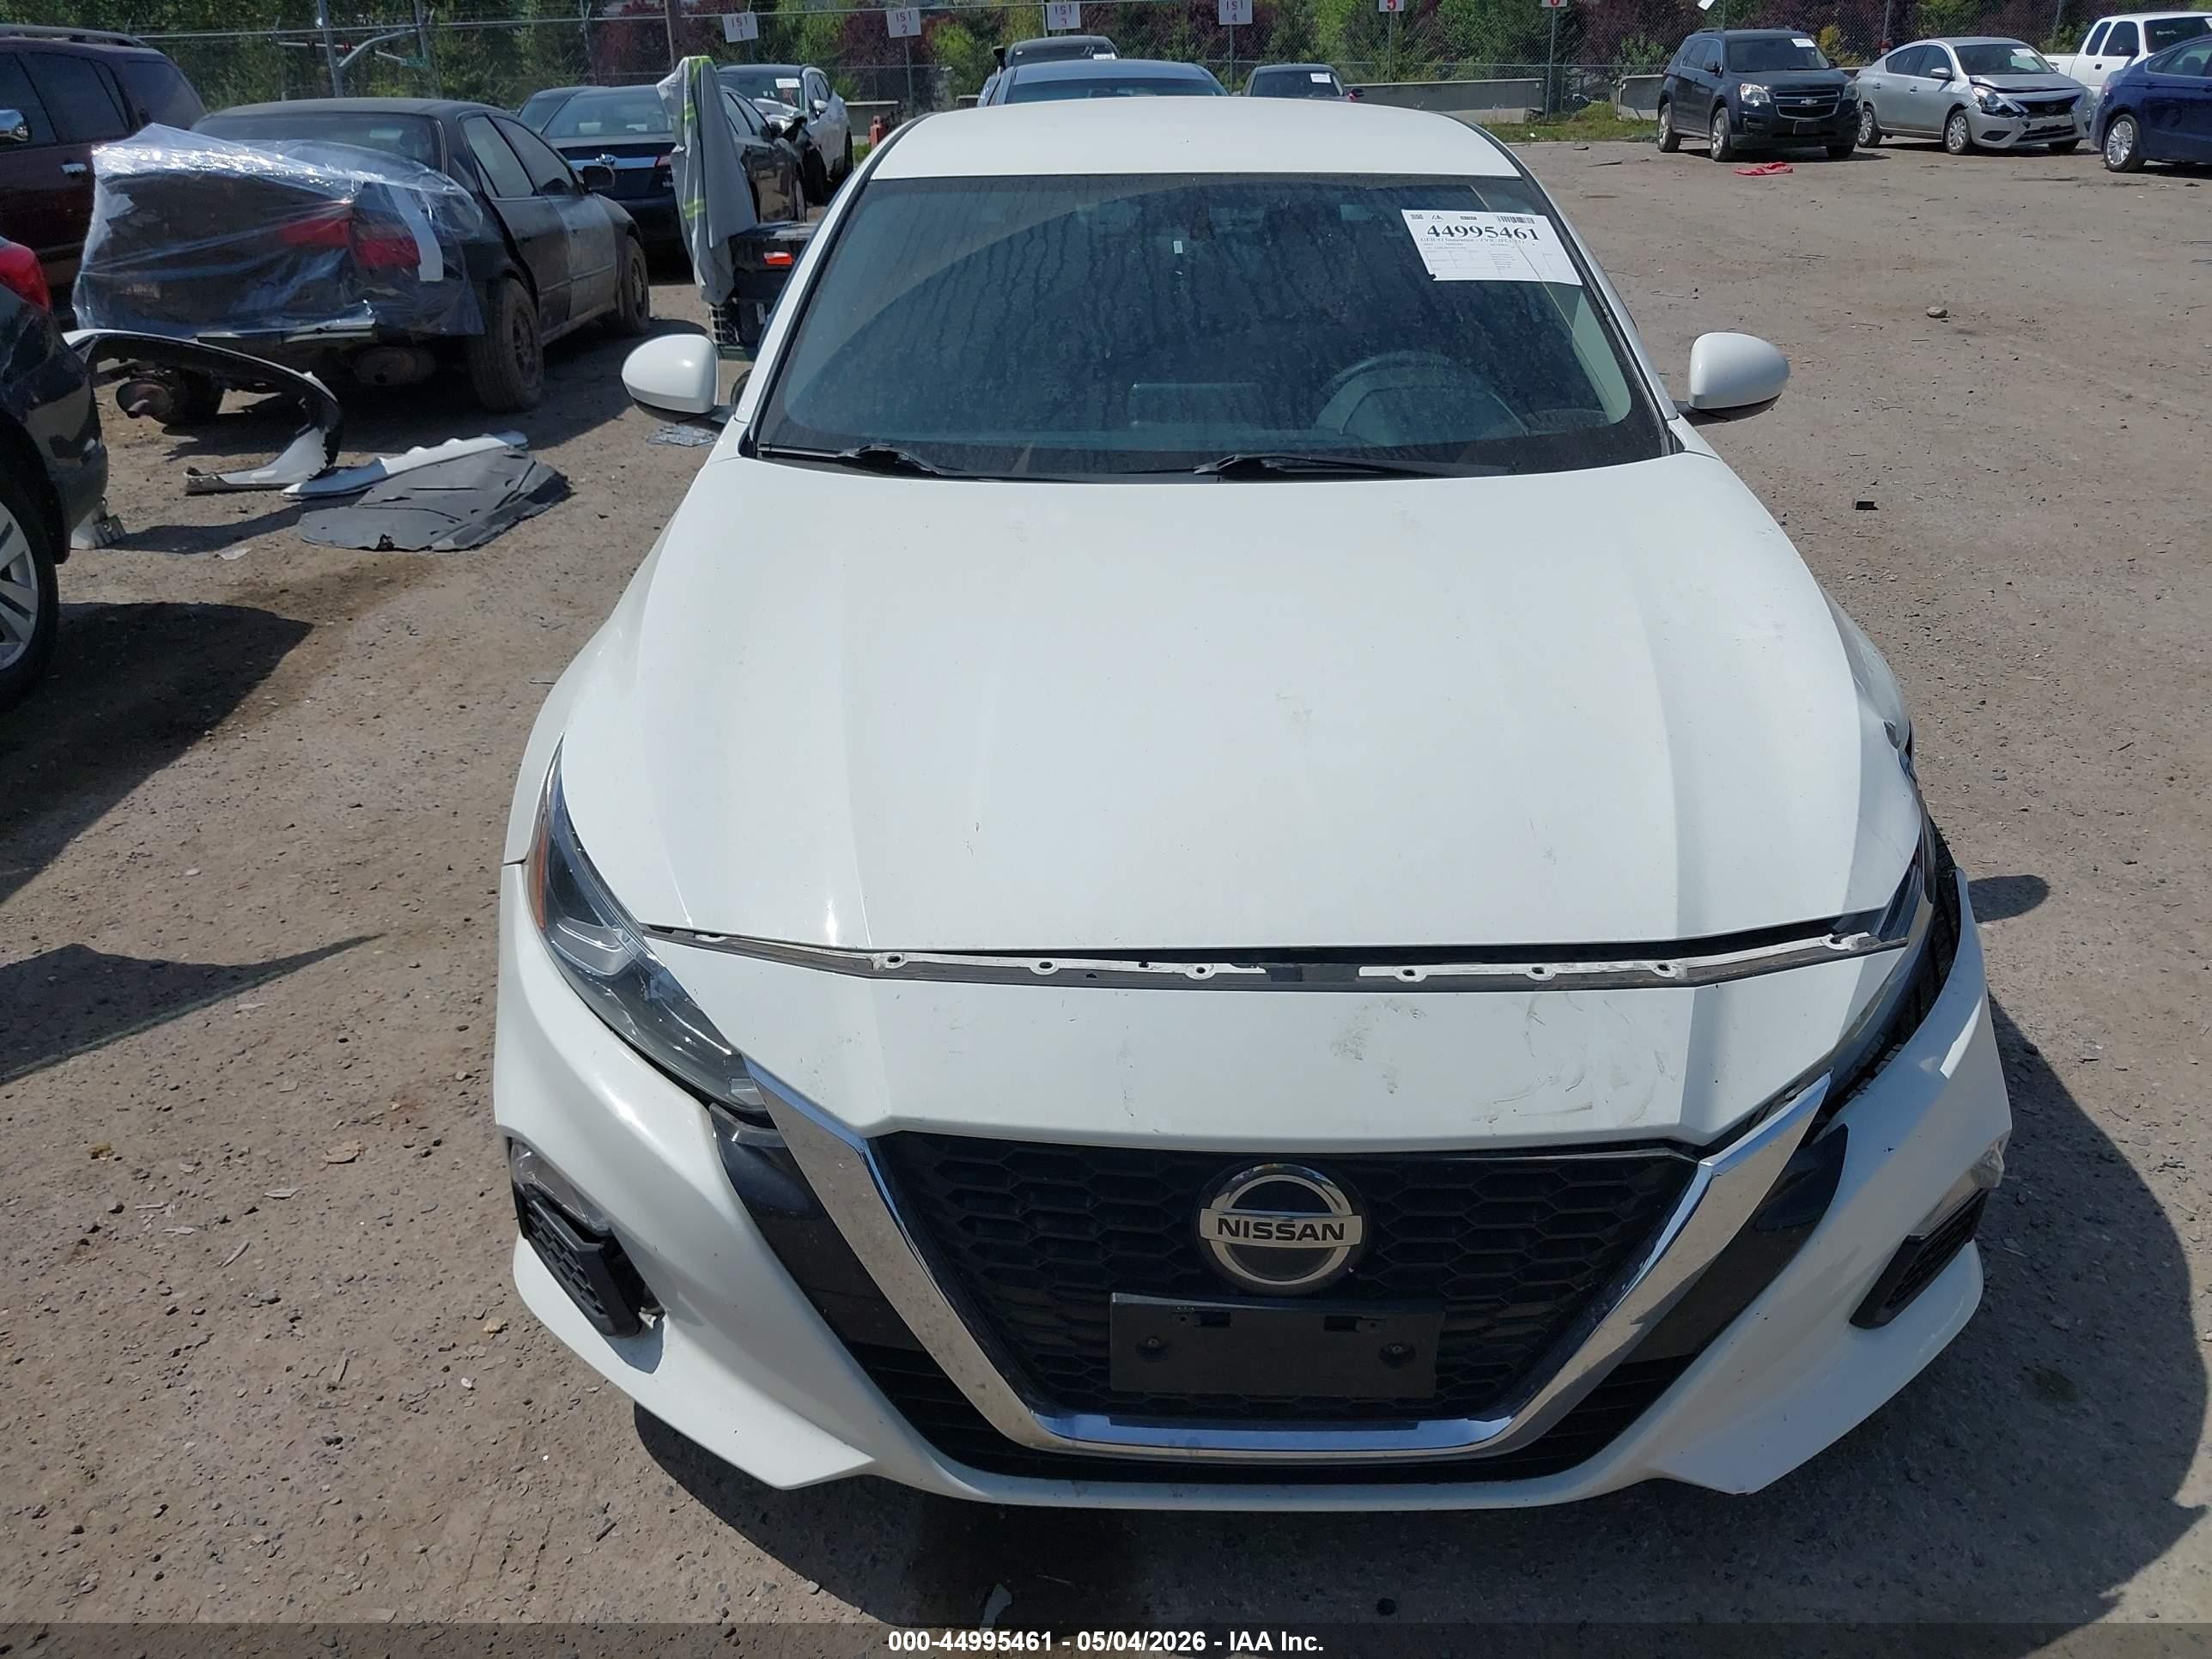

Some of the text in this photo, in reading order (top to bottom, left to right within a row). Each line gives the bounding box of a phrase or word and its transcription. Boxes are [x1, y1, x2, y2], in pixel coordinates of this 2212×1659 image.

[1060, 17, 1067, 27] 3
[1231, 13, 1237, 22] 4
[901, 24, 908, 34] 2
[1427, 224, 1540, 241] 44995461
[1217, 1218, 1345, 1242] NISSAN
